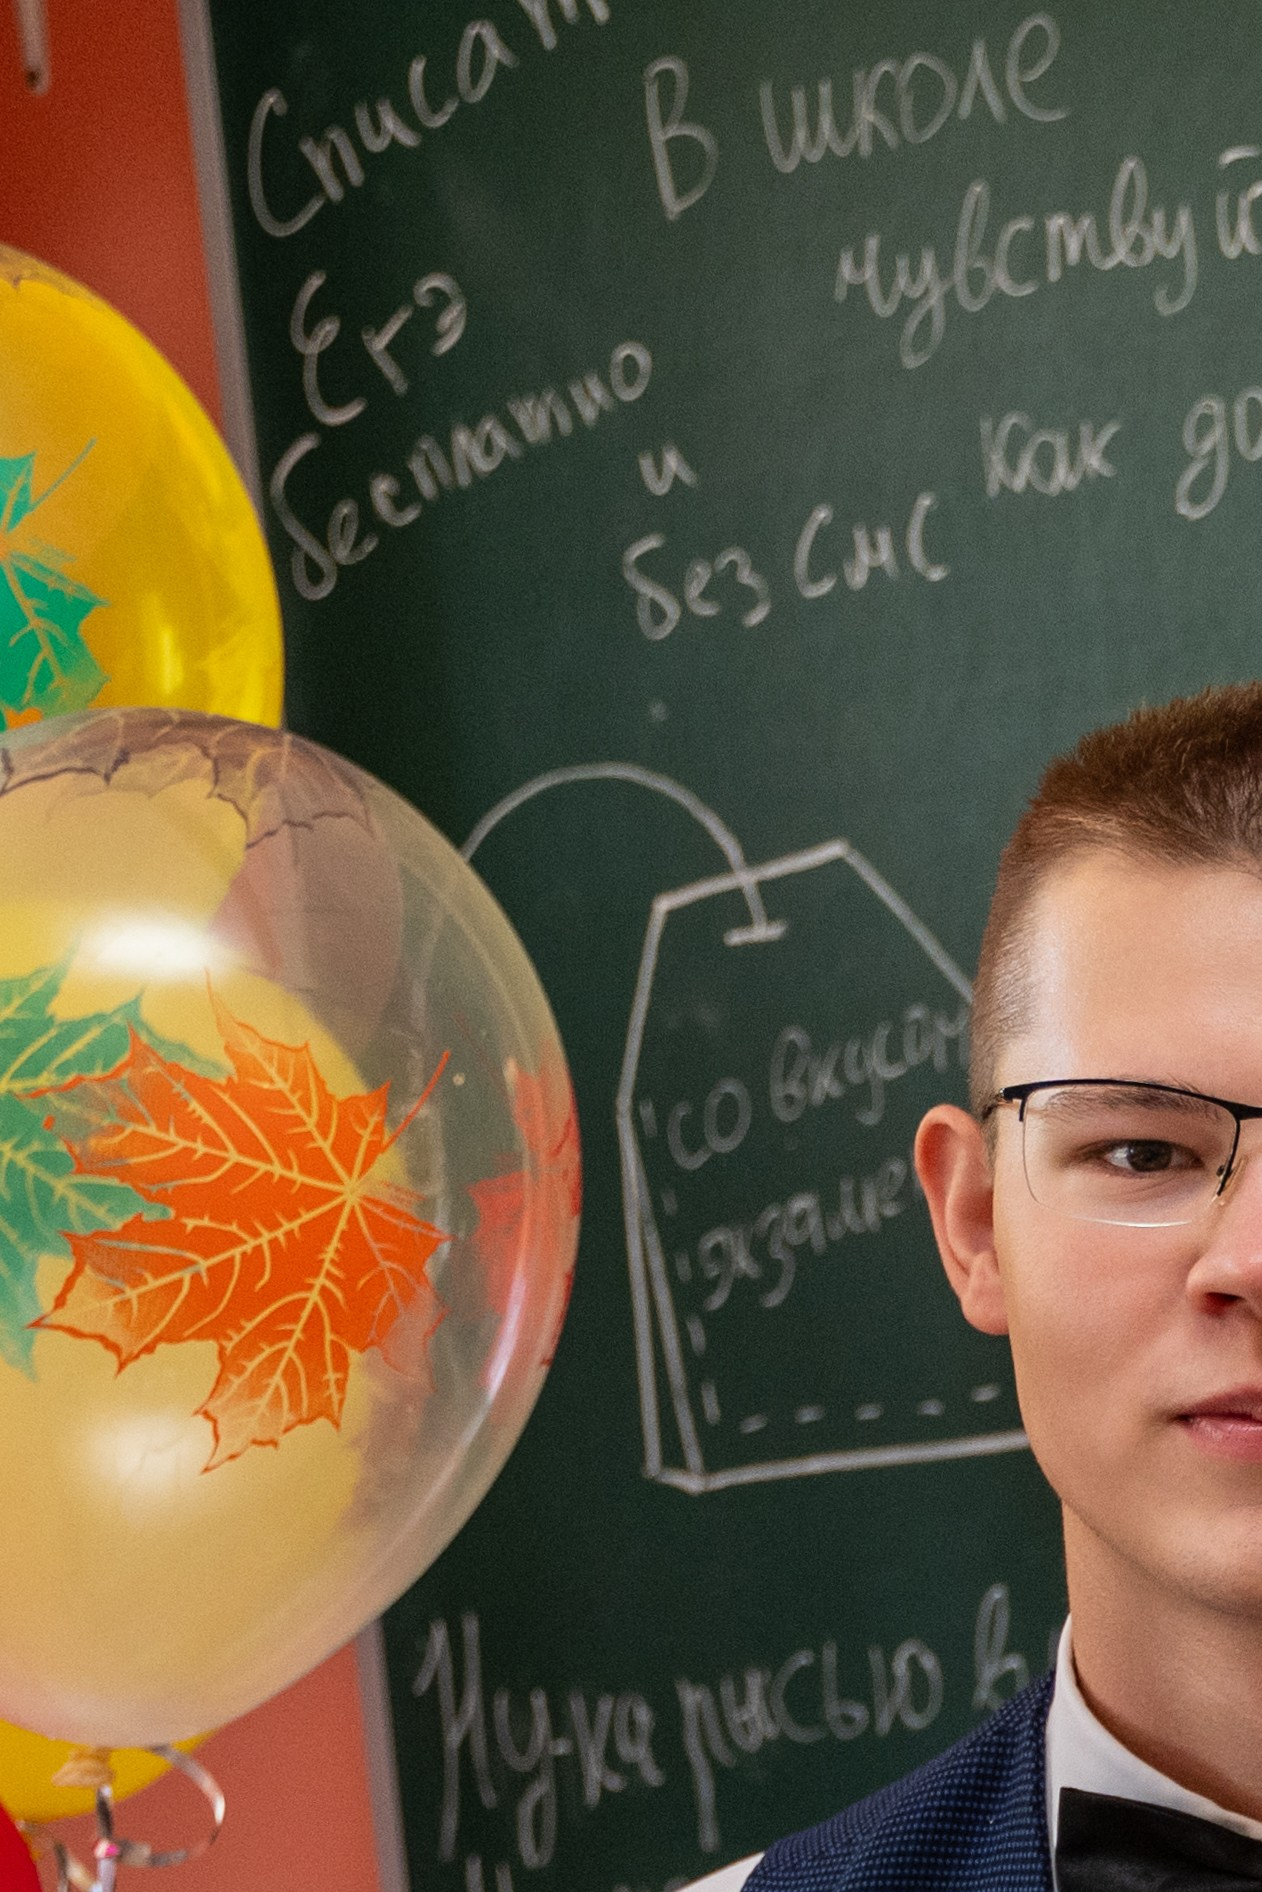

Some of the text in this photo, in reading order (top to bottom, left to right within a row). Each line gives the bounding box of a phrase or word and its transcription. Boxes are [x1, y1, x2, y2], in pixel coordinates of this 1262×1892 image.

[644, 10, 1069, 222] В школе
[980, 410, 1122, 499] как
[622, 532, 771, 641] без
